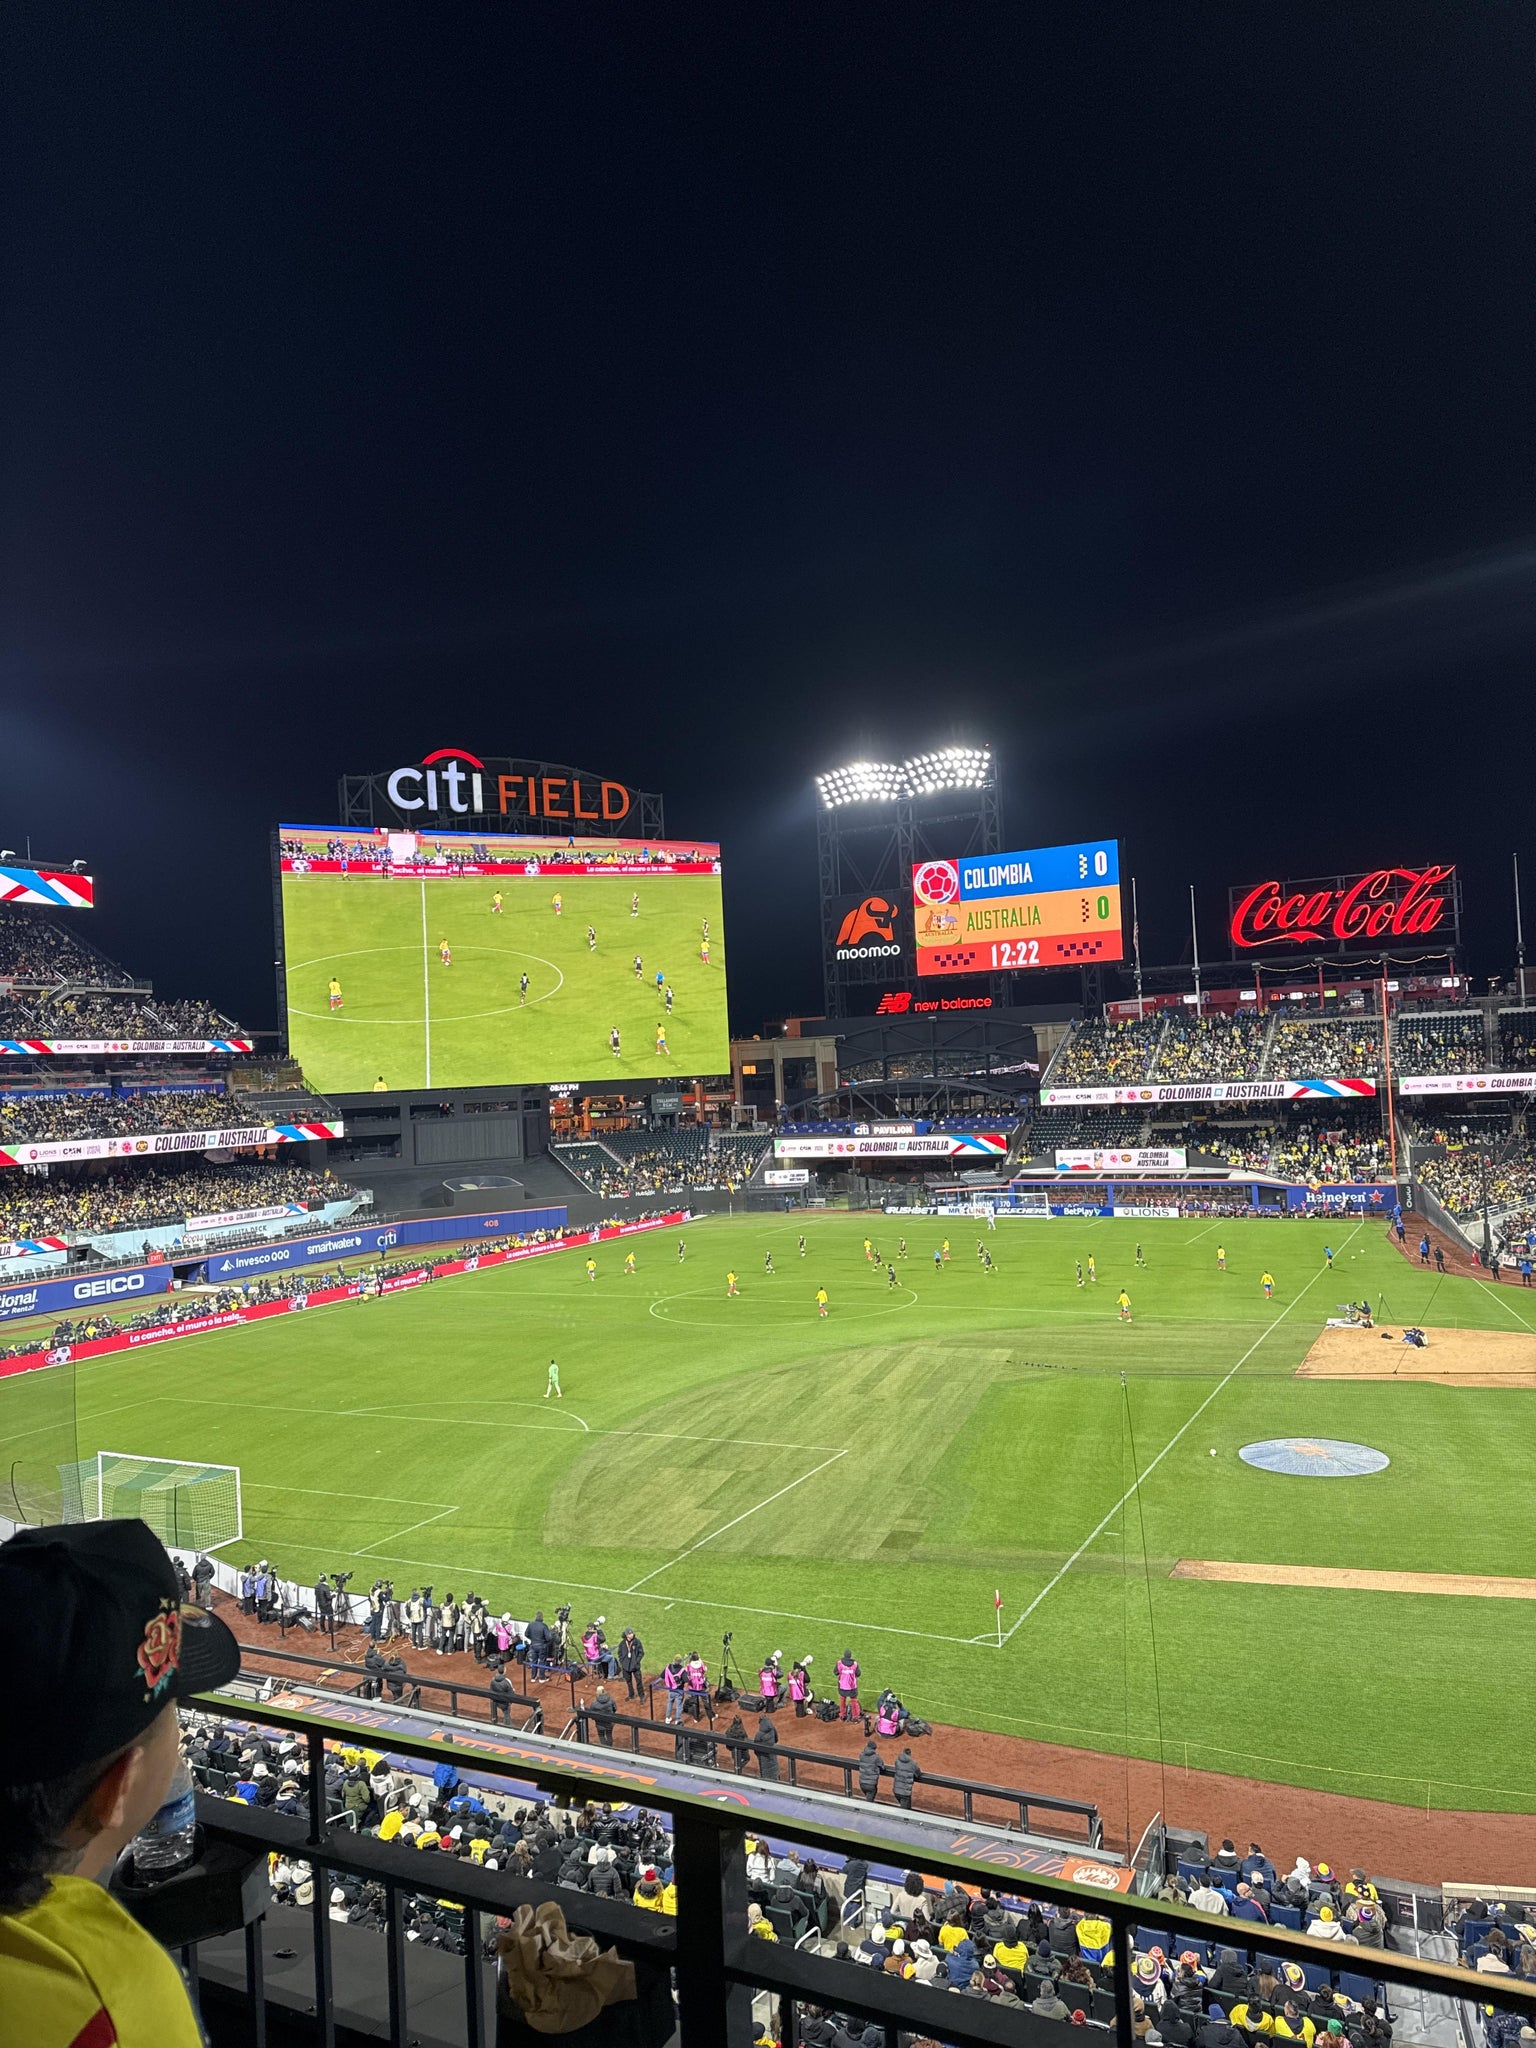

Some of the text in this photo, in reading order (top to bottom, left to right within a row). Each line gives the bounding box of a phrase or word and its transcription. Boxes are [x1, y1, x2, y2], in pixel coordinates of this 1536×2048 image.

[387, 759, 630, 820] citi FIELD
[964, 863, 1033, 889] COLOMBIA
[1095, 851, 1107, 876] 0
[1231, 864, 1456, 947] Coca-Cola
[967, 896, 1109, 931] AUSTRALIA 0
[837, 945, 900, 960] moomoo
[991, 940, 1040, 967] 12:22
[914, 1001, 938, 1011] new
[941, 997, 992, 1010] balance
[132, 1042, 206, 1051] COLOMBIA AUSTRALIA
[1491, 1078, 1533, 1088] COLOMBIA
[1159, 1084, 1284, 1100] COLOMBIA AUSTRALIA
[874, 1126, 913, 1135] PAVILION
[155, 1129, 267, 1151] COLOMBIA AUSTRALIA
[859, 1140, 949, 1153] COLOMBIA AUSTRALIA
[1138, 1151, 1169, 1159] COLOMBIA
[1137, 1159, 1169, 1167] AUSTRALIA
[1064, 1207, 1094, 1217] BetPlay
[1131, 1209, 1170, 1217] LIONS
[307, 1236, 355, 1255] smartwater
[236, 1249, 290, 1269] Invesco QQQ
[74, 1274, 144, 1299] GEICO
[11, 1304, 35, 1314] Rental
[129, 1335, 140, 1343] La
[141, 1328, 175, 1340] cancha,
[186, 1321, 207, 1330] muro
